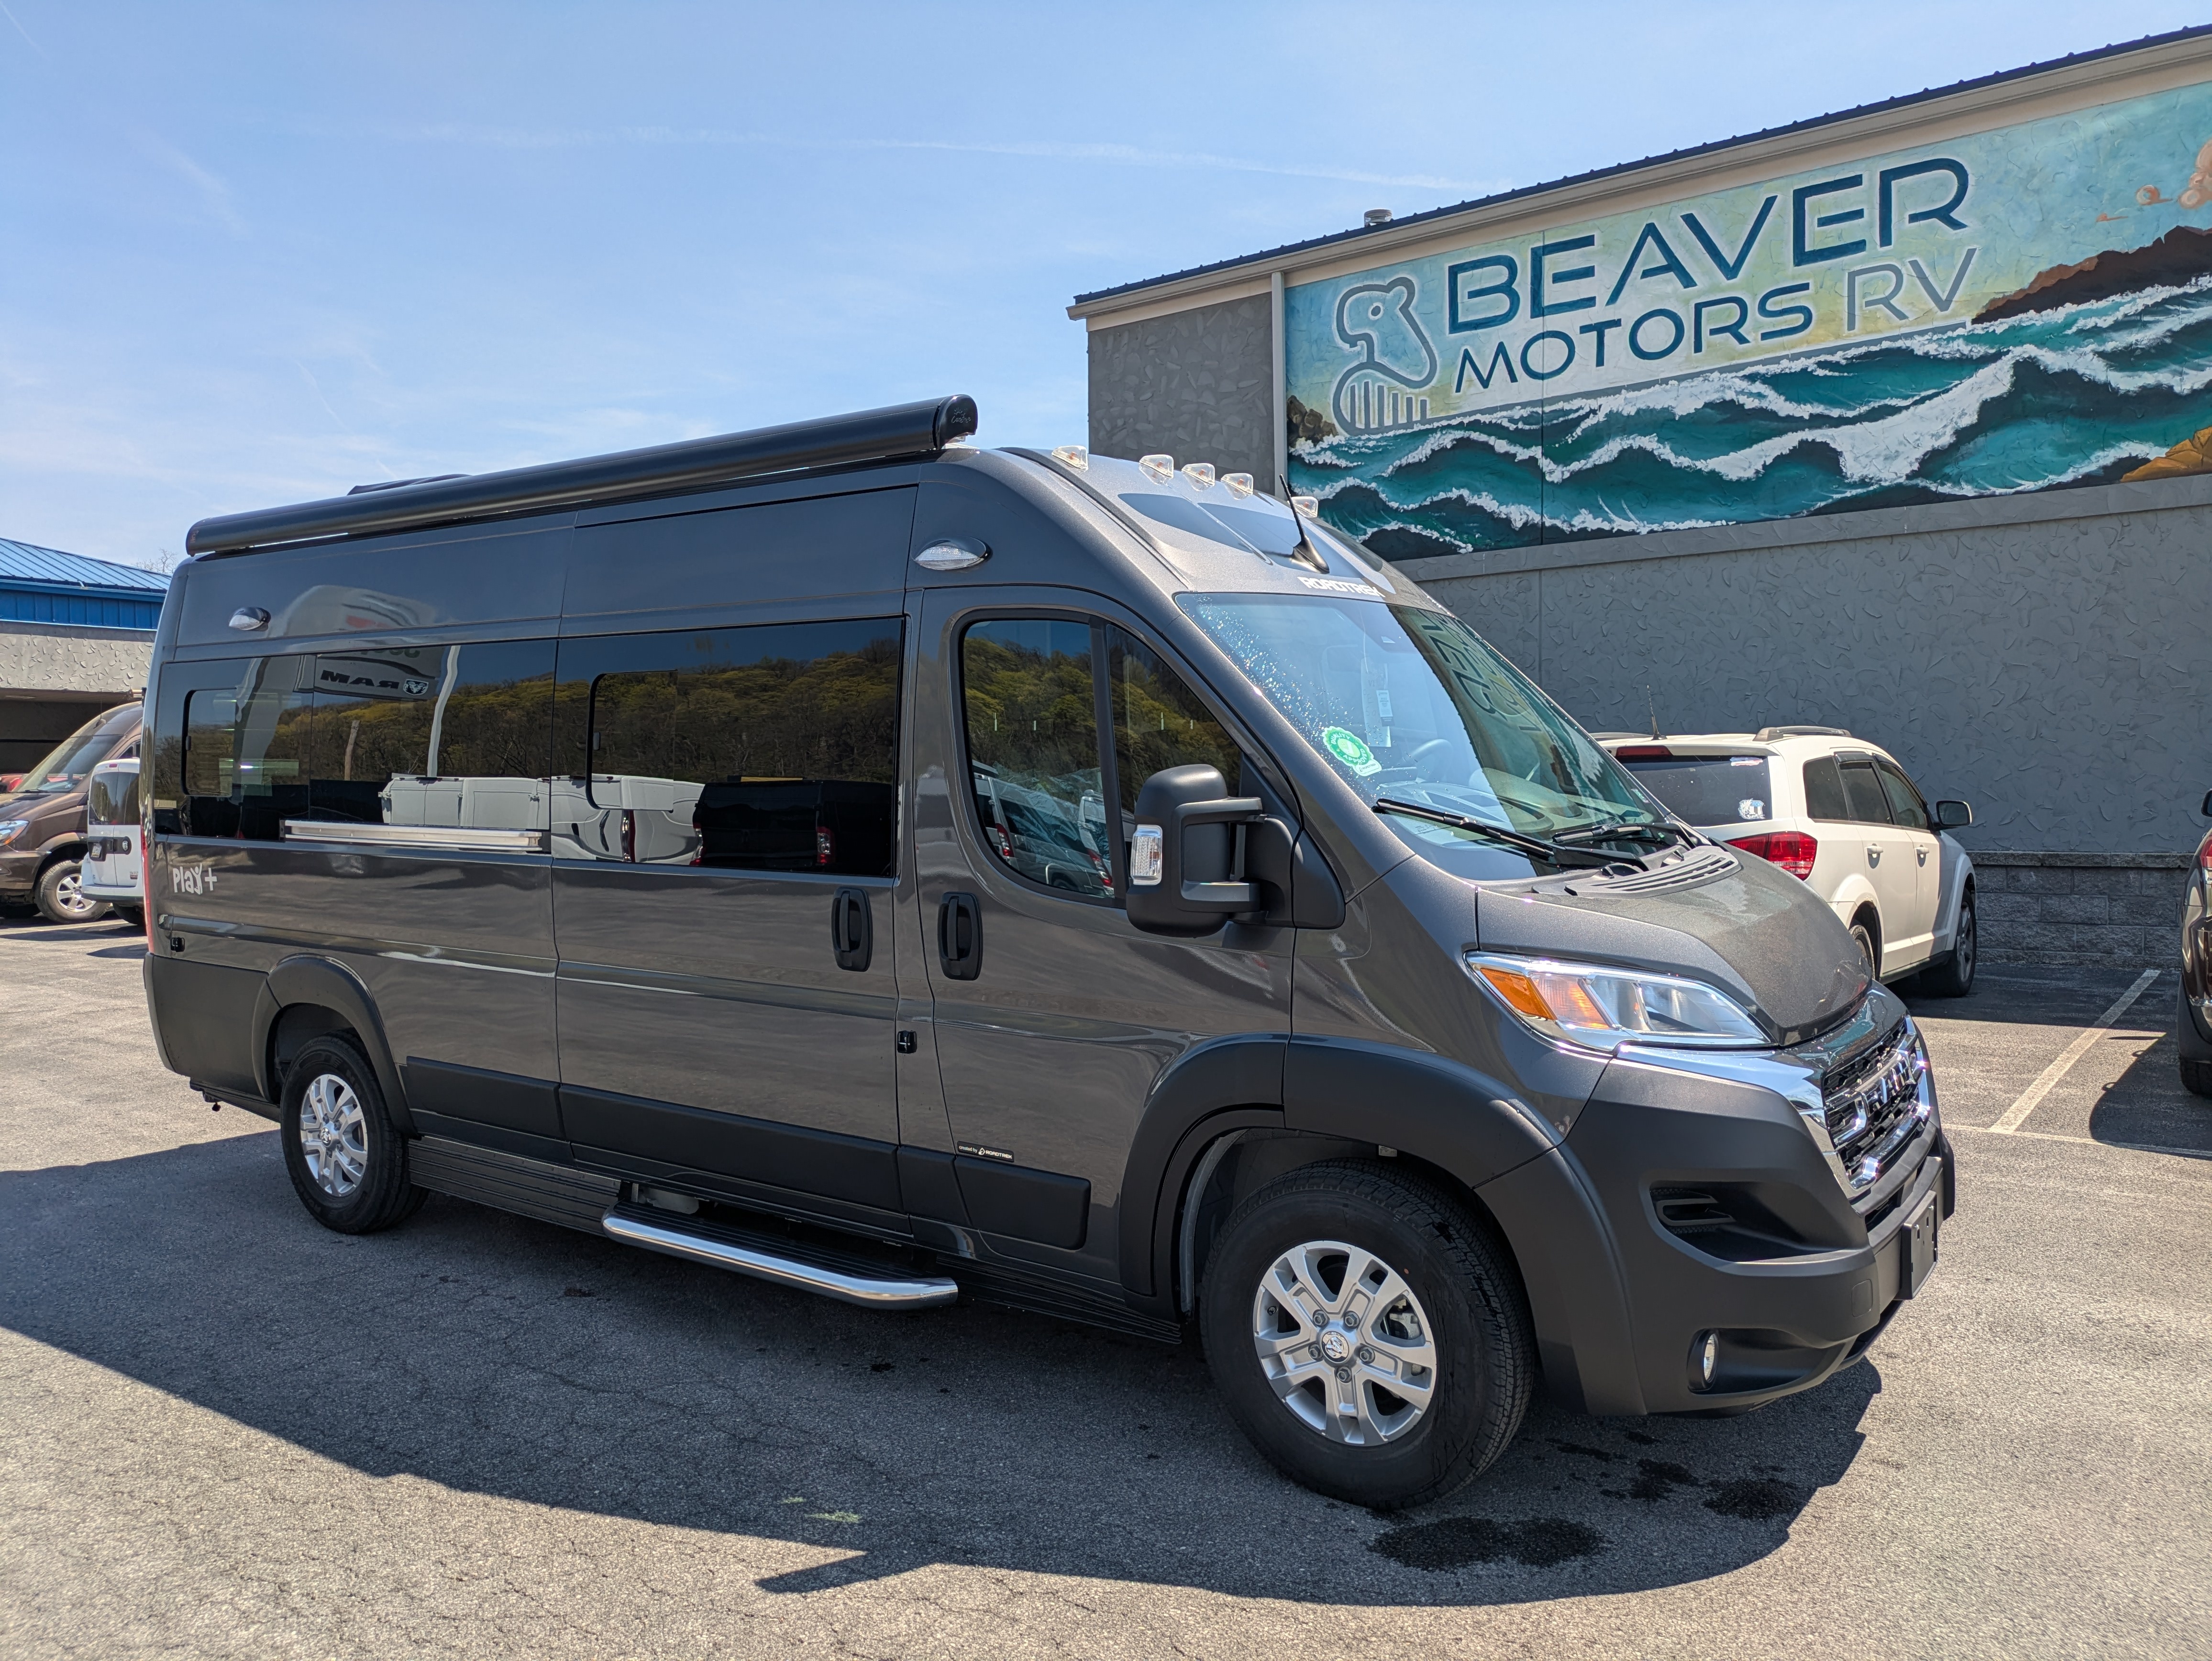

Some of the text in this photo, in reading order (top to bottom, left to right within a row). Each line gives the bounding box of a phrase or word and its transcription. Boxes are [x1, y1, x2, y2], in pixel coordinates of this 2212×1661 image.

[1447, 157, 1971, 334] BEAVER
[1454, 247, 1977, 394] MOTORS RV
[1297, 576, 1386, 598] ROADTREK
[1330, 732, 1350, 745] QUALITY
[1343, 748, 1367, 765] APPROVED
[985, 1150, 1012, 1159] ROADTREK
